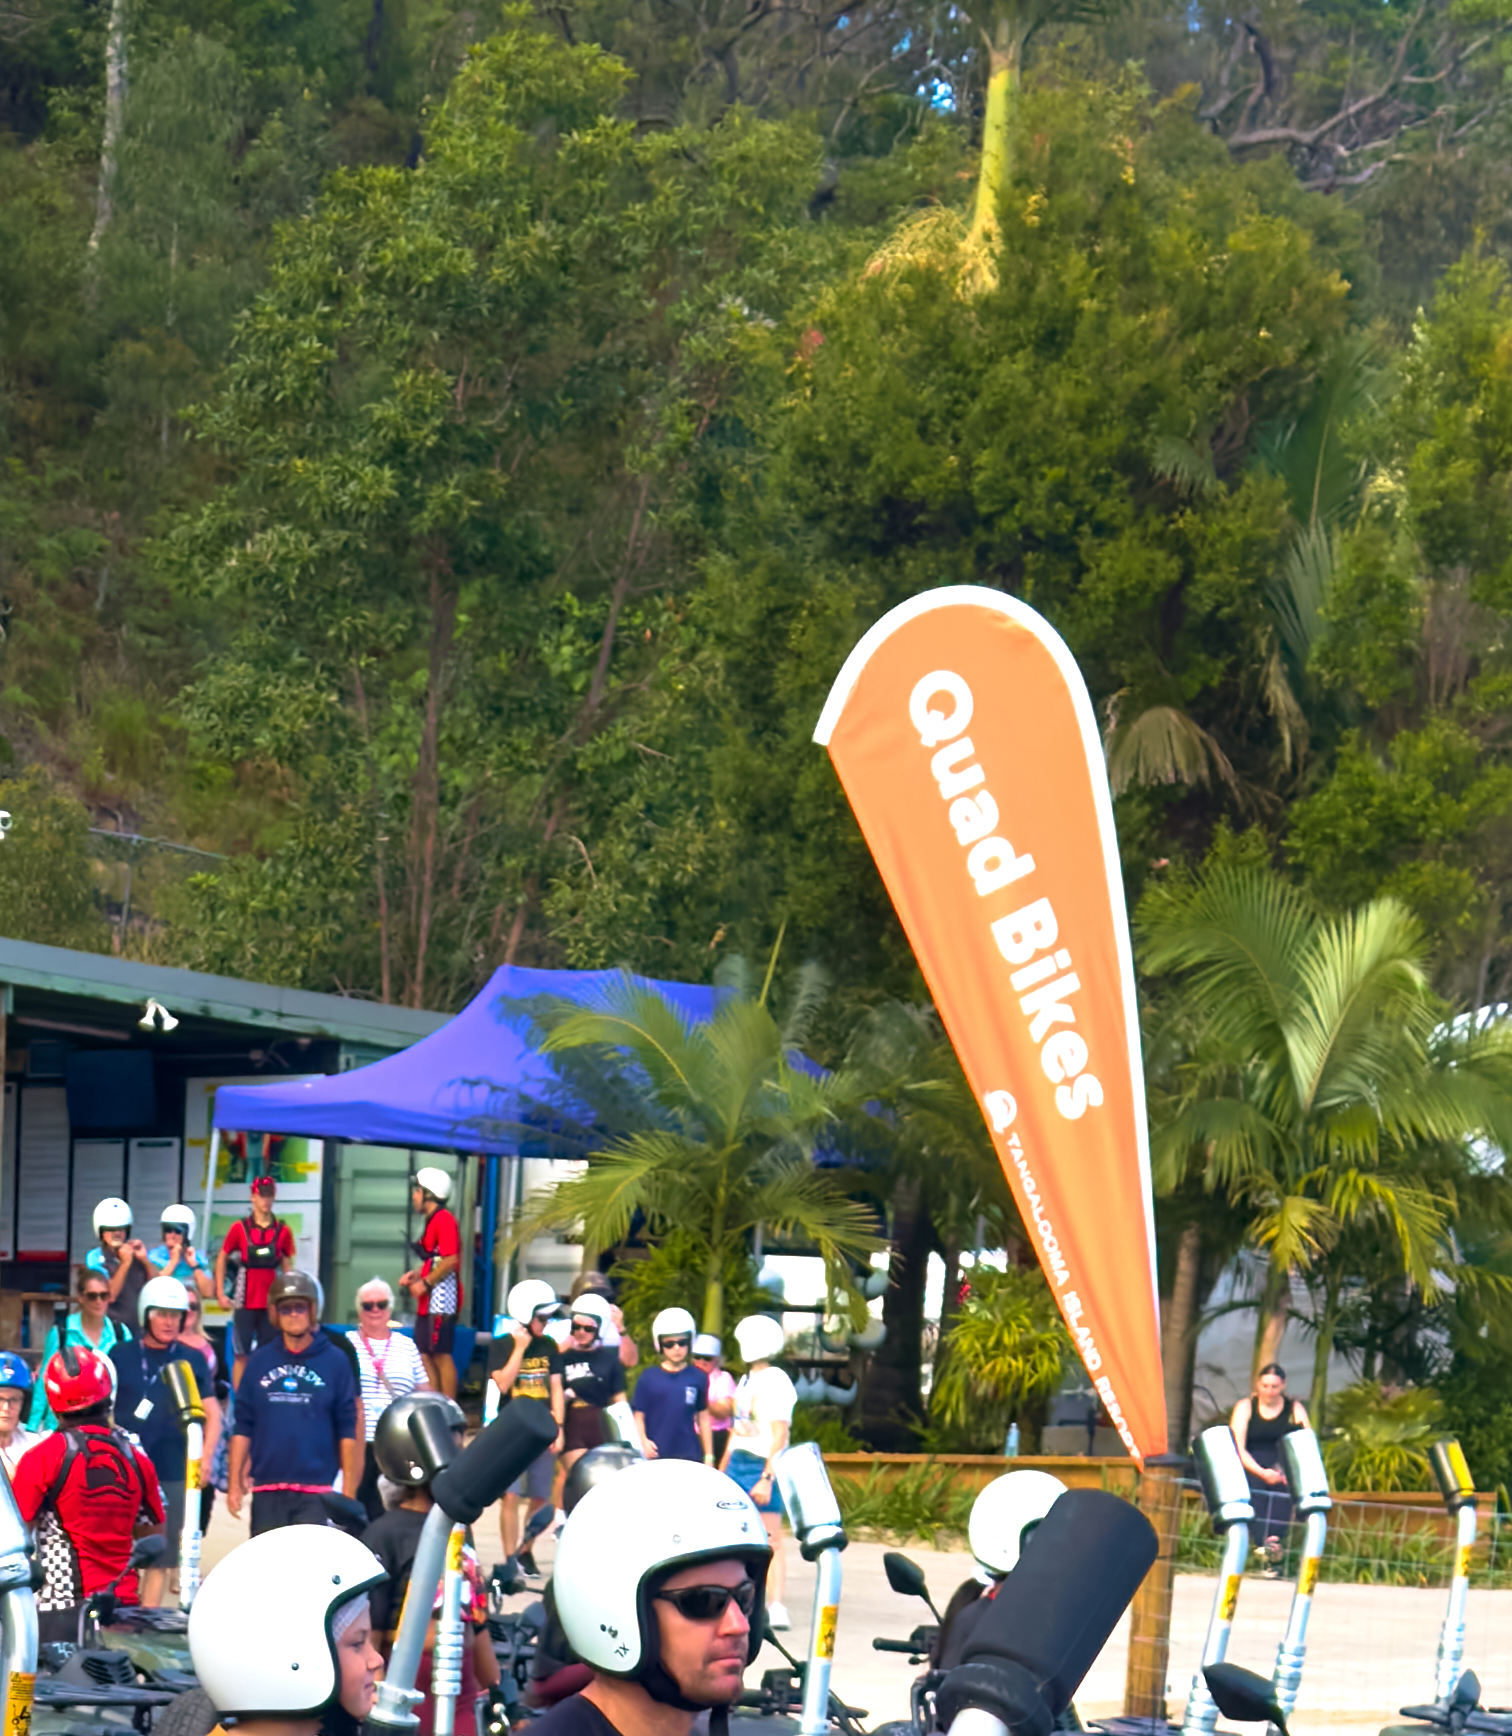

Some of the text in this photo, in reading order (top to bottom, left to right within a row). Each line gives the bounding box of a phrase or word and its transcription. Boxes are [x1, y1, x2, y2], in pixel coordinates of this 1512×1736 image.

[908, 669, 1104, 1119] Quad Bikes
[1006, 1132, 1142, 1460] TANGALOOMA ISLAND RESORT
